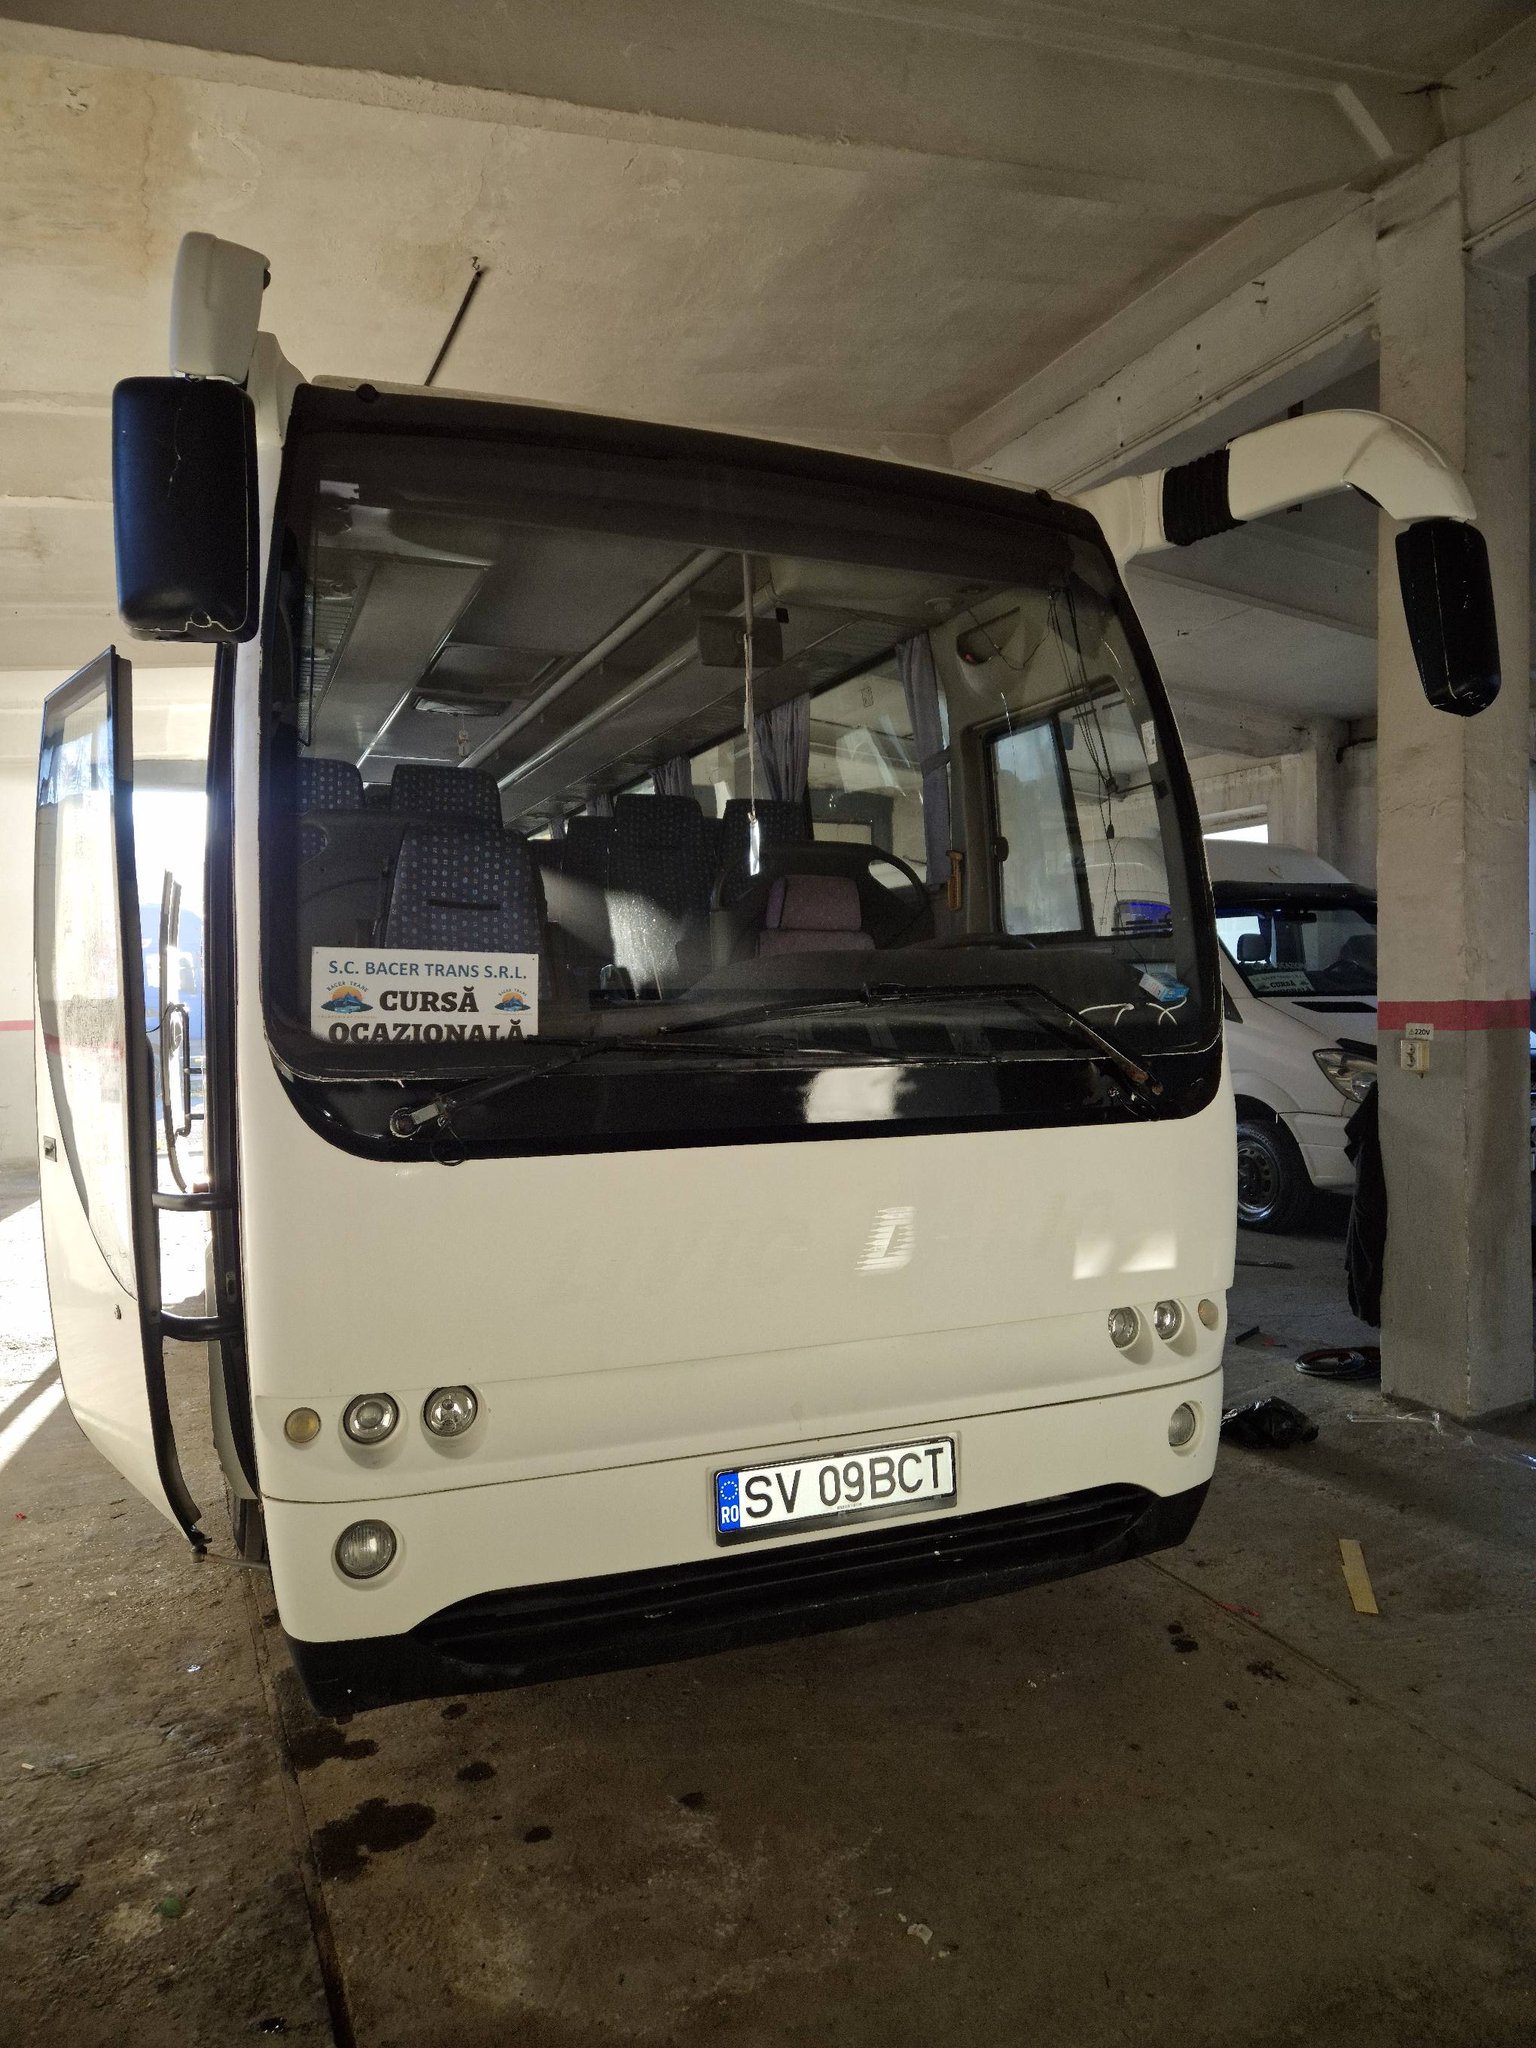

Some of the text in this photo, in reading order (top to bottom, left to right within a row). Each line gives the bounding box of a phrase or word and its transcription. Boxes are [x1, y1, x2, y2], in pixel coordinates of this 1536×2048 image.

[328, 960, 527, 979] S.C. BACER TRANS S.R.L.
[379, 985, 480, 1013] CURSĂ
[1414, 1028, 1431, 1036] 220V
[745, 1447, 944, 1518] SV 09BCT
[721, 1504, 740, 1524] RO
